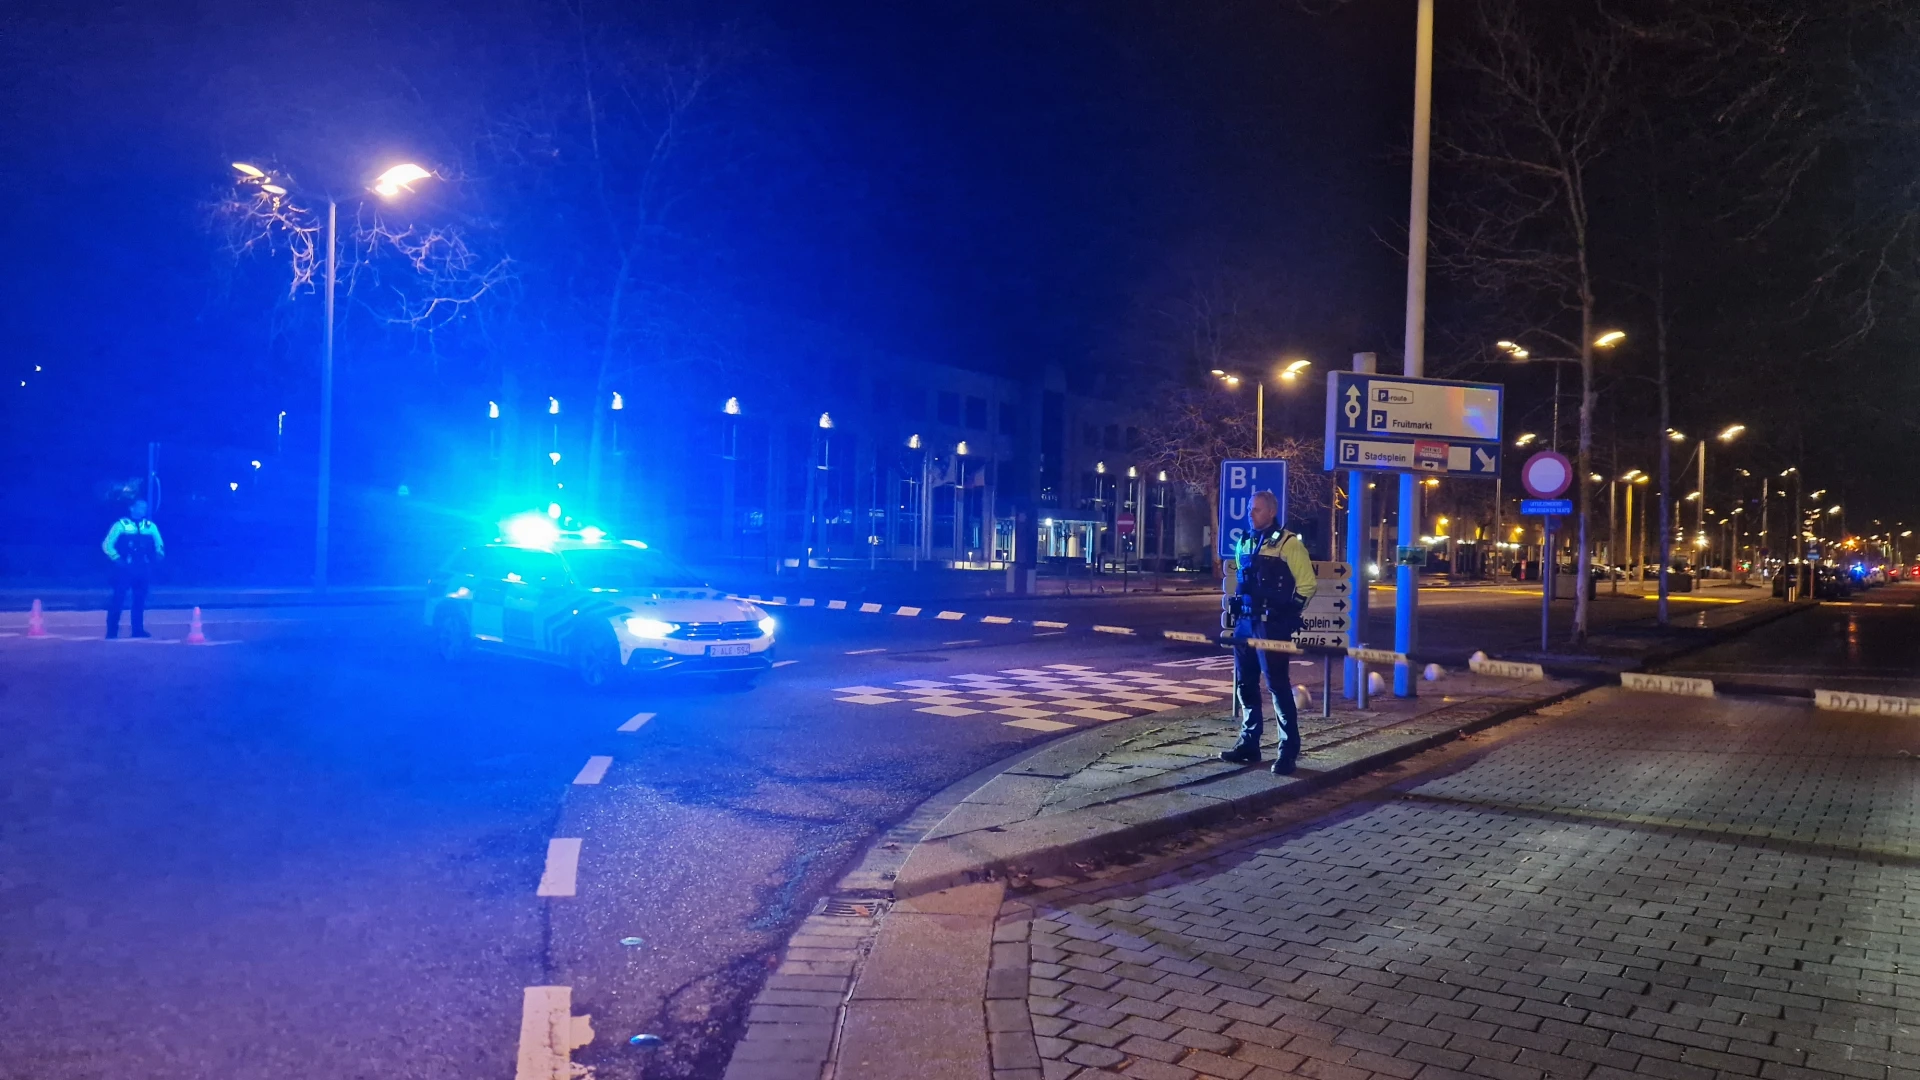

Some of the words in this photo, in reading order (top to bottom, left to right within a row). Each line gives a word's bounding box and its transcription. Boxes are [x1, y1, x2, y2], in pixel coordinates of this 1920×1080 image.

[1392, 419, 1432, 430] Fruitmarkt
[1364, 452, 1406, 462] Stadsplein
[1302, 616, 1331, 631] splein
